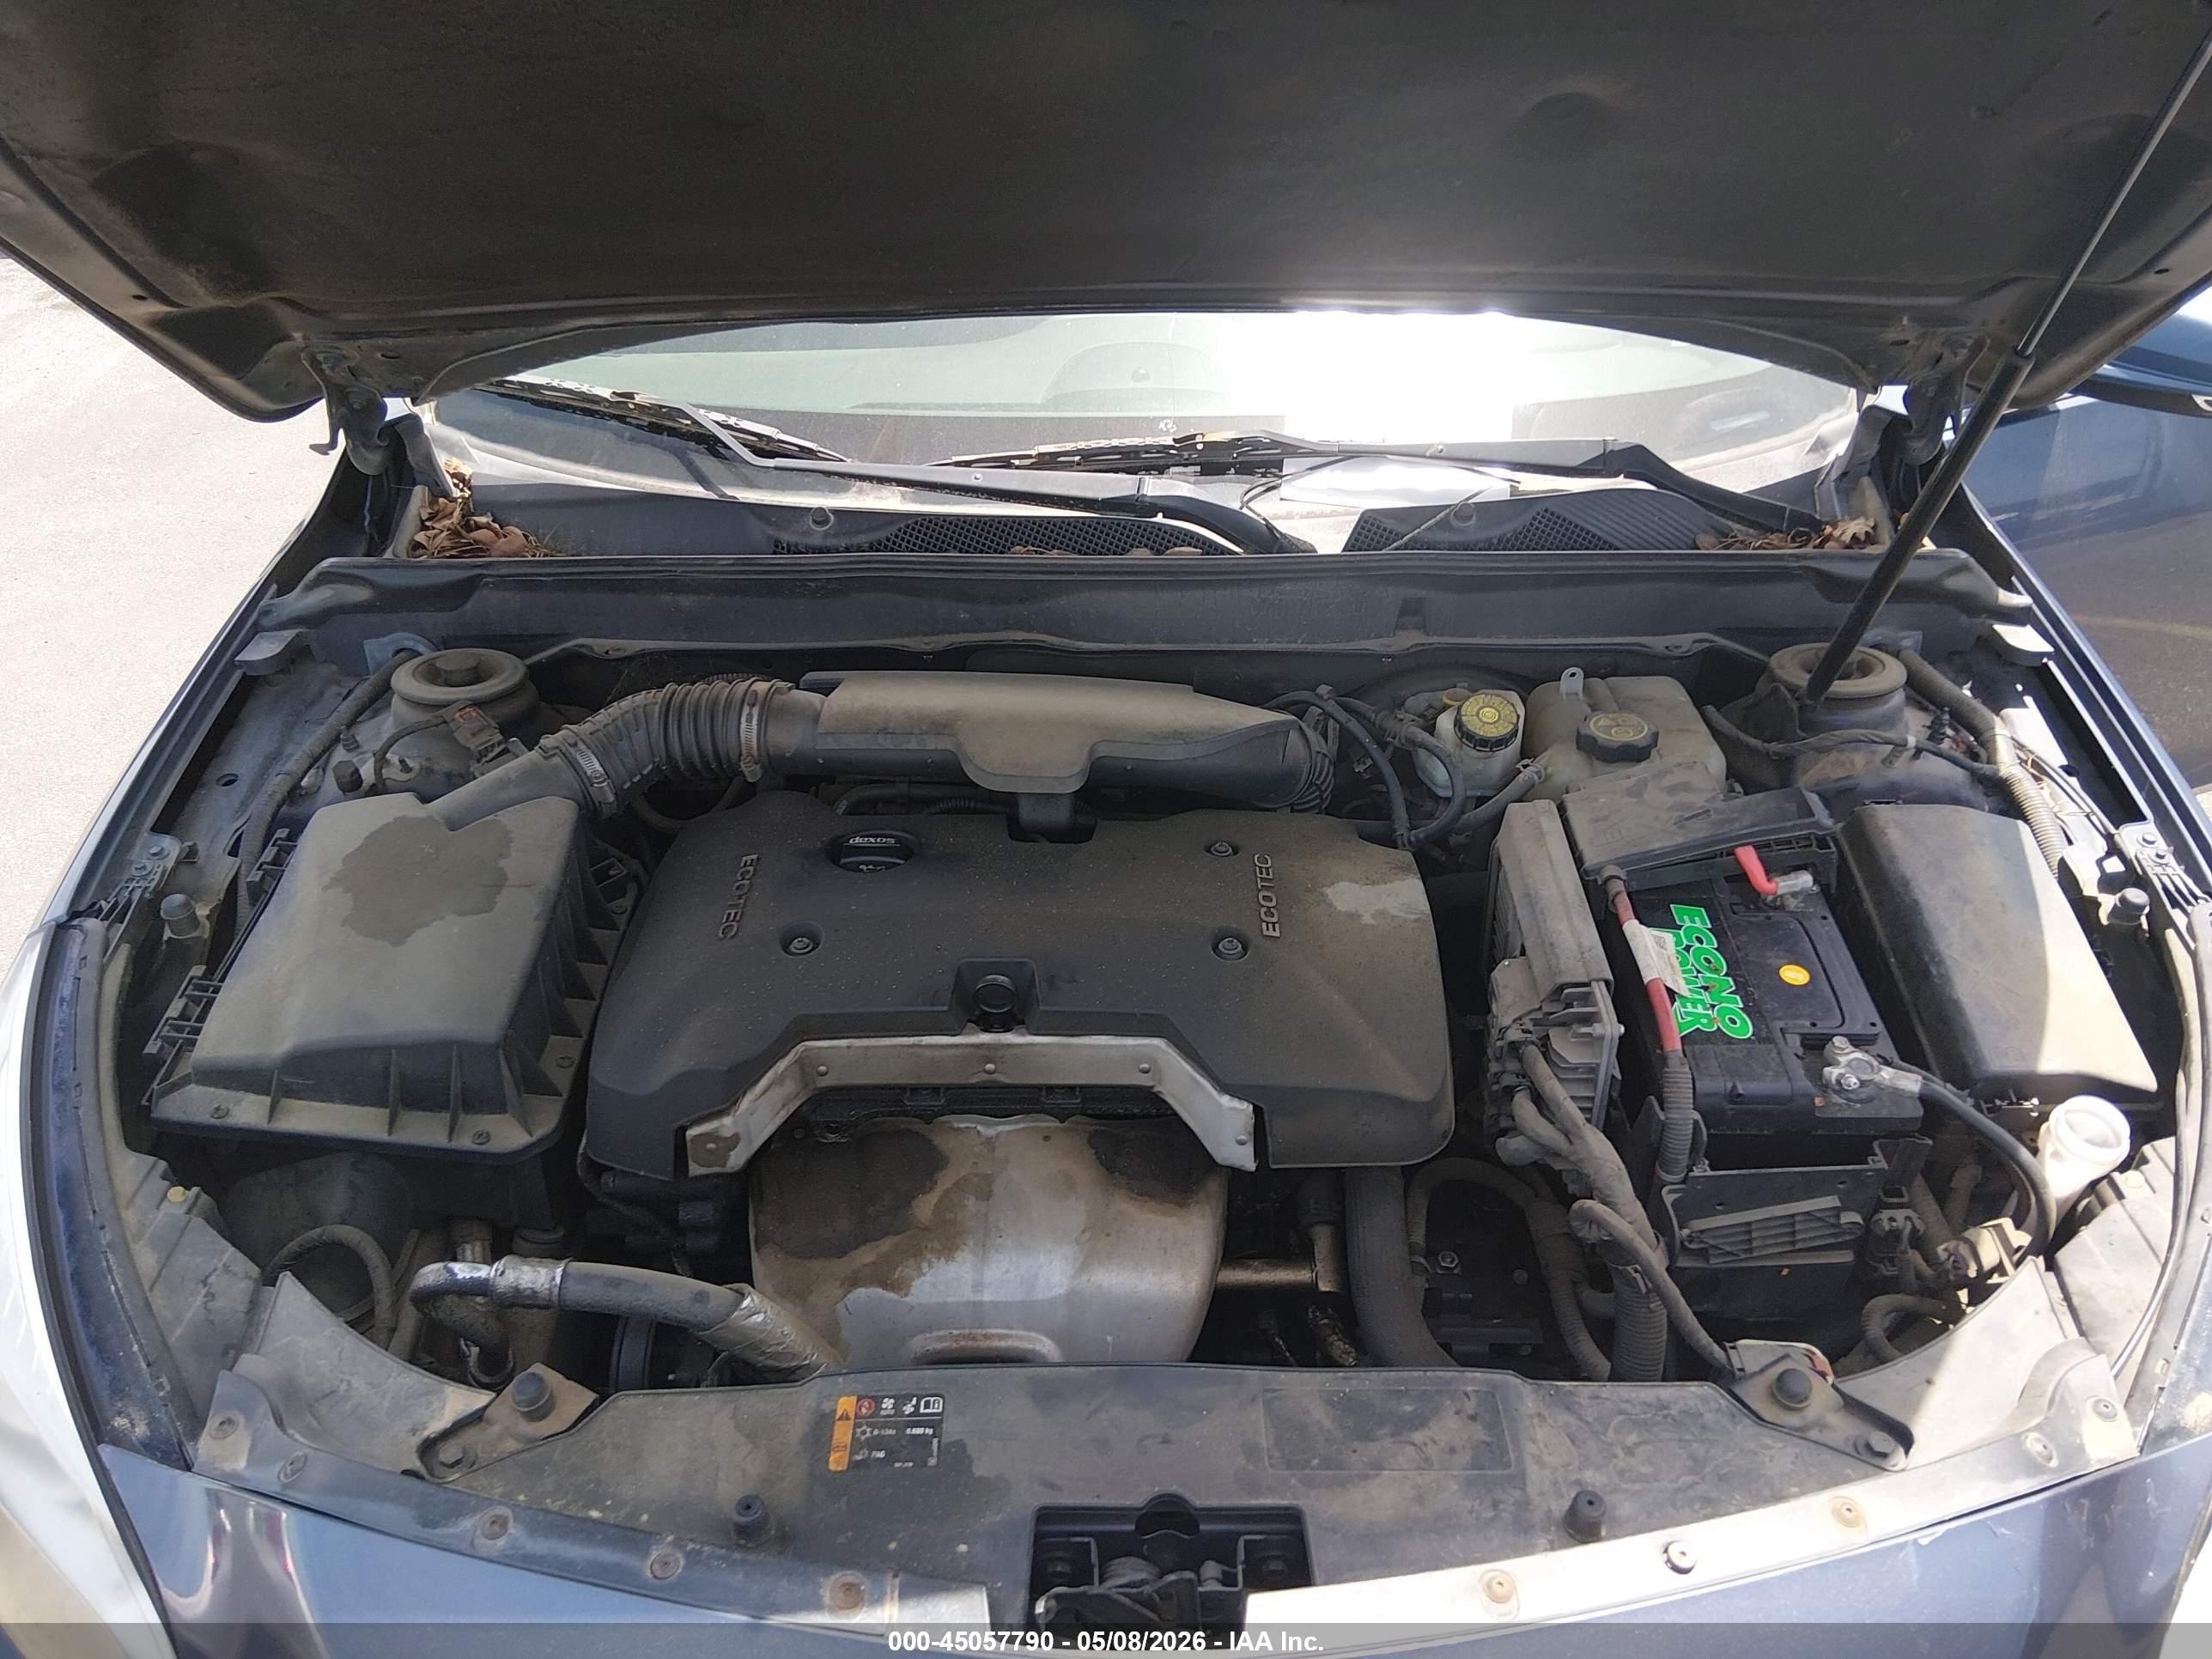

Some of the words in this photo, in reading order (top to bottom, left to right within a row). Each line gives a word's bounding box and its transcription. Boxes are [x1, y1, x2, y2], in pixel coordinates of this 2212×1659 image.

[718, 854, 758, 939] ECOTEC
[1254, 853, 1281, 938] ECOTEC
[1670, 904, 1753, 1039] ECONO
